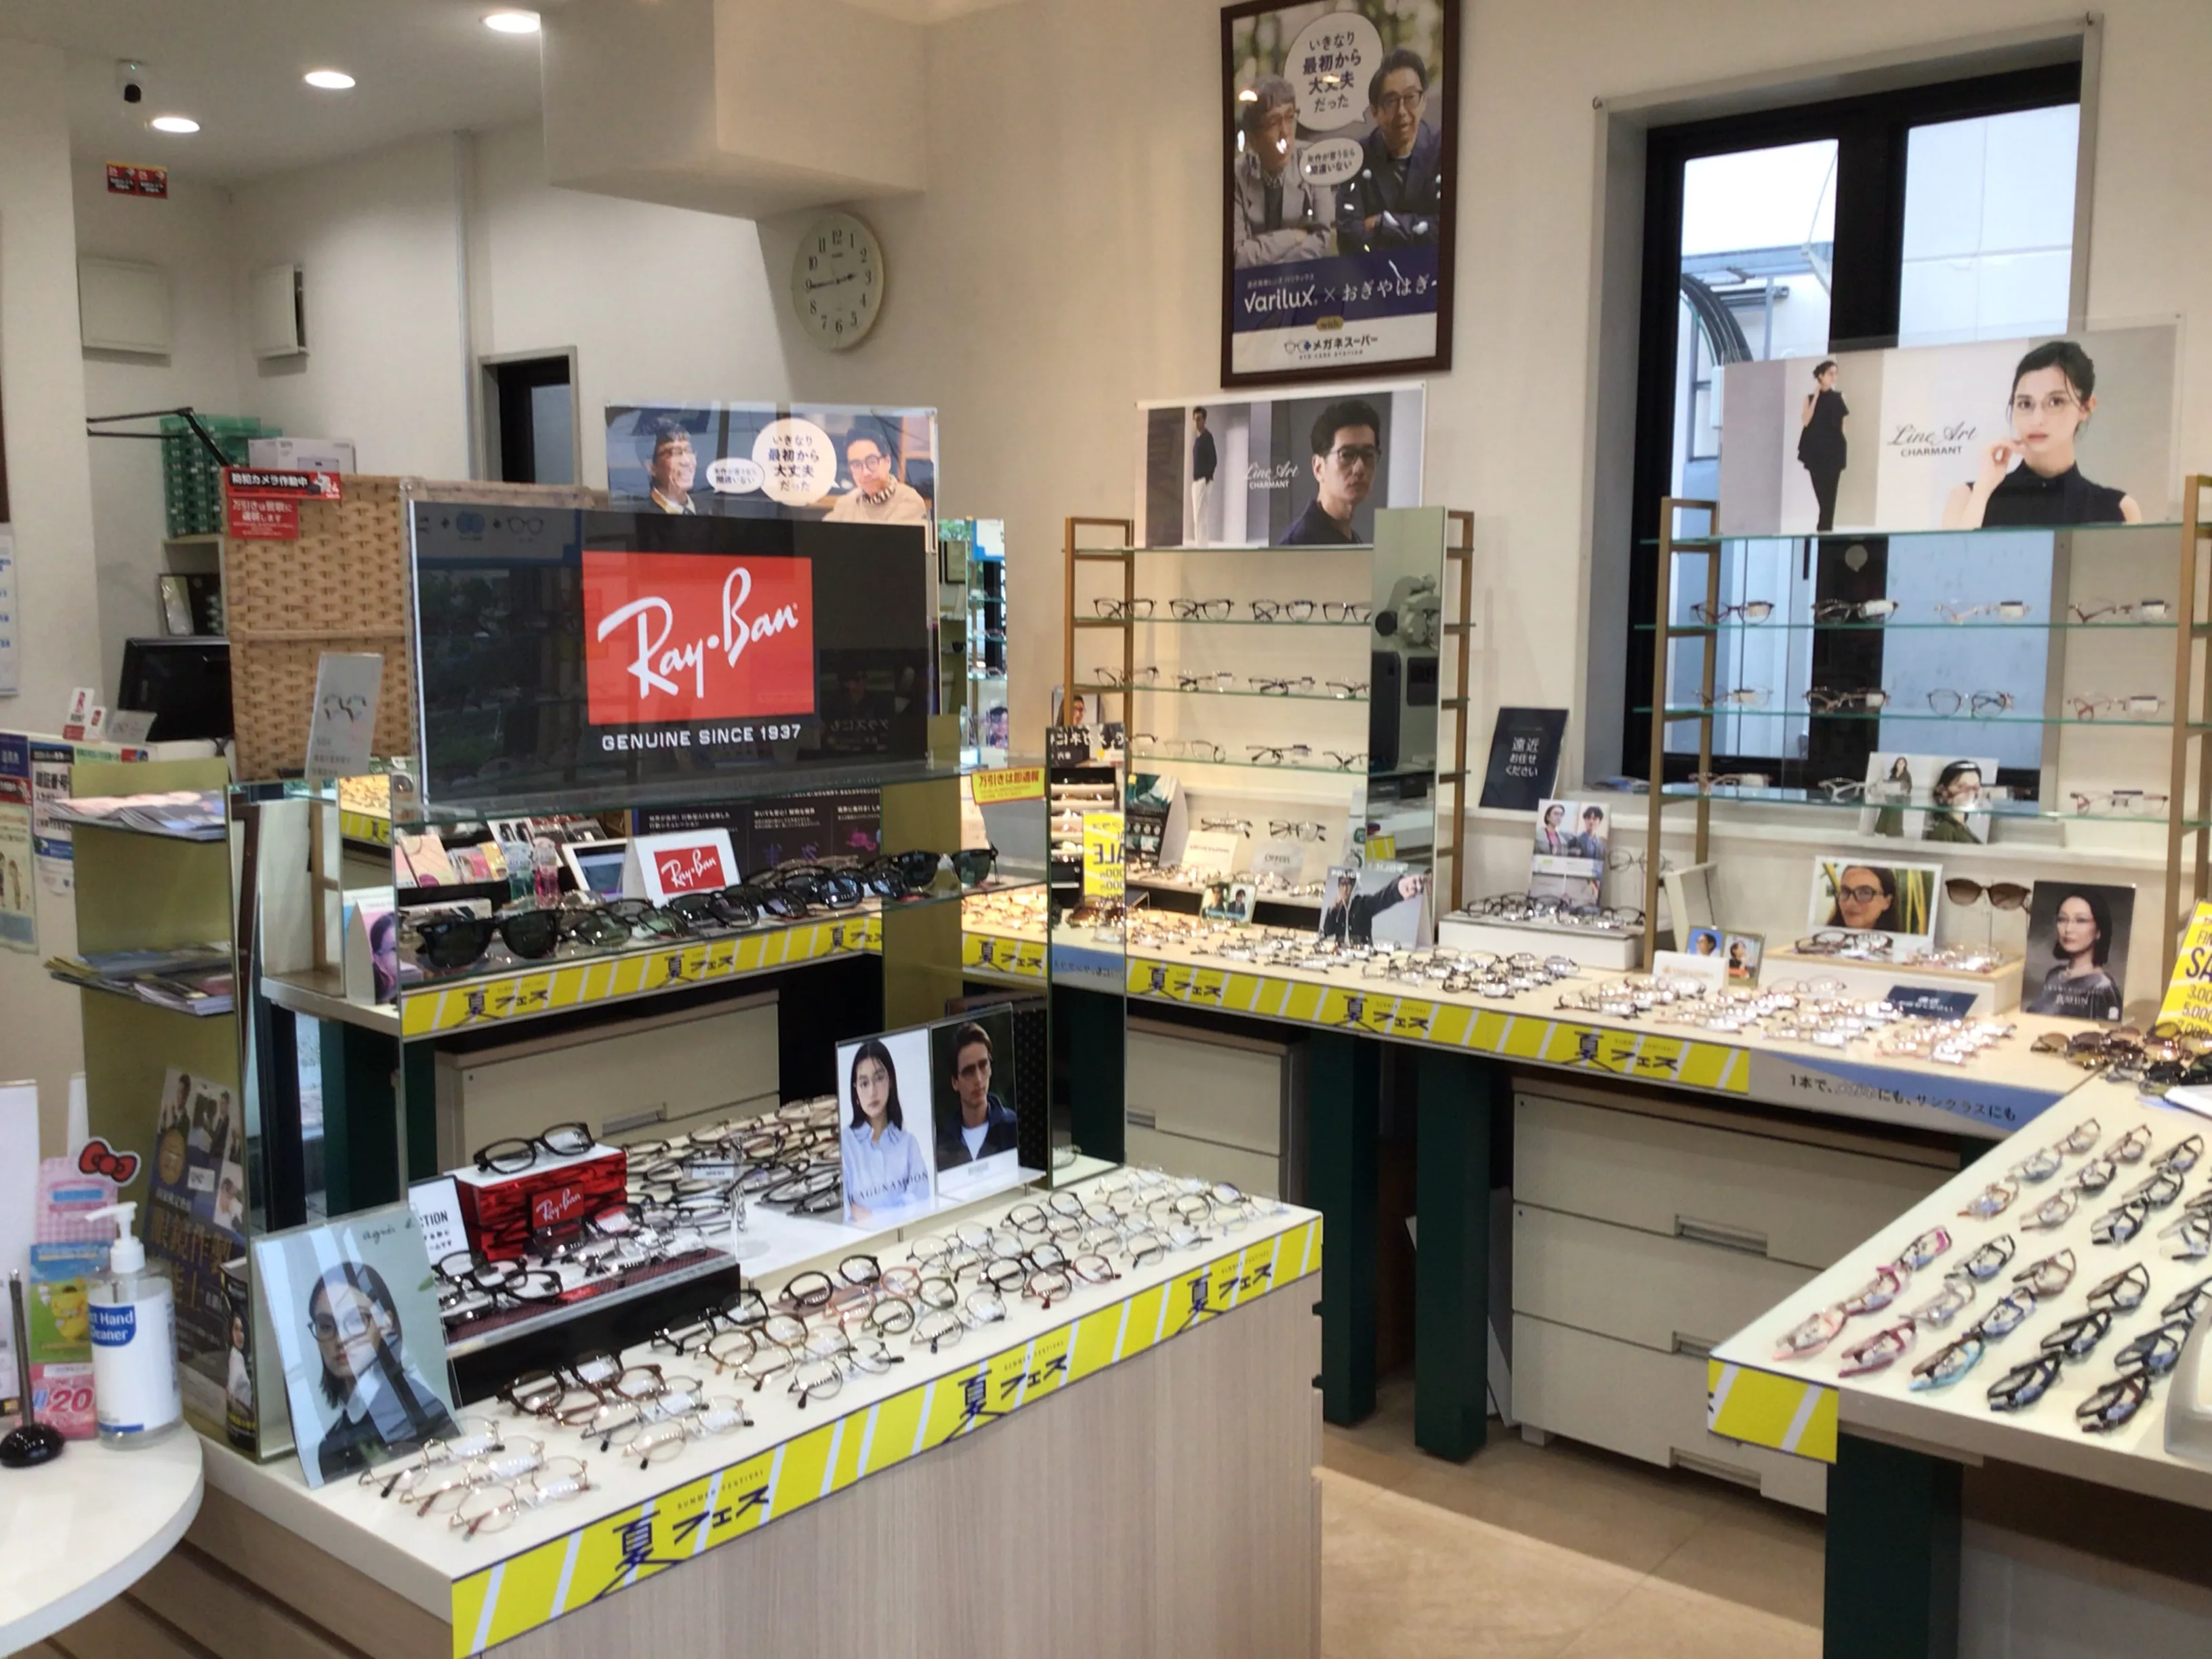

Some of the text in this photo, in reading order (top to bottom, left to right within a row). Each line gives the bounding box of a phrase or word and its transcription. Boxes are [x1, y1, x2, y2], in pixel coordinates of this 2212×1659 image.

[1309, 32, 1354, 51] いきなり
[1303, 49, 1361, 75] 最初から
[1315, 94, 1349, 112] だった
[1313, 334, 1378, 351] メガネスーパー
[773, 434, 813, 447] いきなり
[768, 447, 820, 463] 最初から
[1900, 446, 1962, 457] CHARMANT
[773, 464, 815, 478] 大丈夫
[781, 480, 811, 492] だった
[602, 723, 801, 751] GENUINE SINCE 1937
[1512, 736, 1540, 753] 遠近
[1510, 753, 1537, 764] お任せ
[1505, 764, 1538, 777] ください
[1560, 1029, 1679, 1073] 夏フェス
[1174, 1263, 1272, 1336] 夏フェス
[100, 1309, 134, 1326] Hand
[941, 1353, 1067, 1445] 夏フェス
[592, 1484, 769, 1603] 夏フェス
